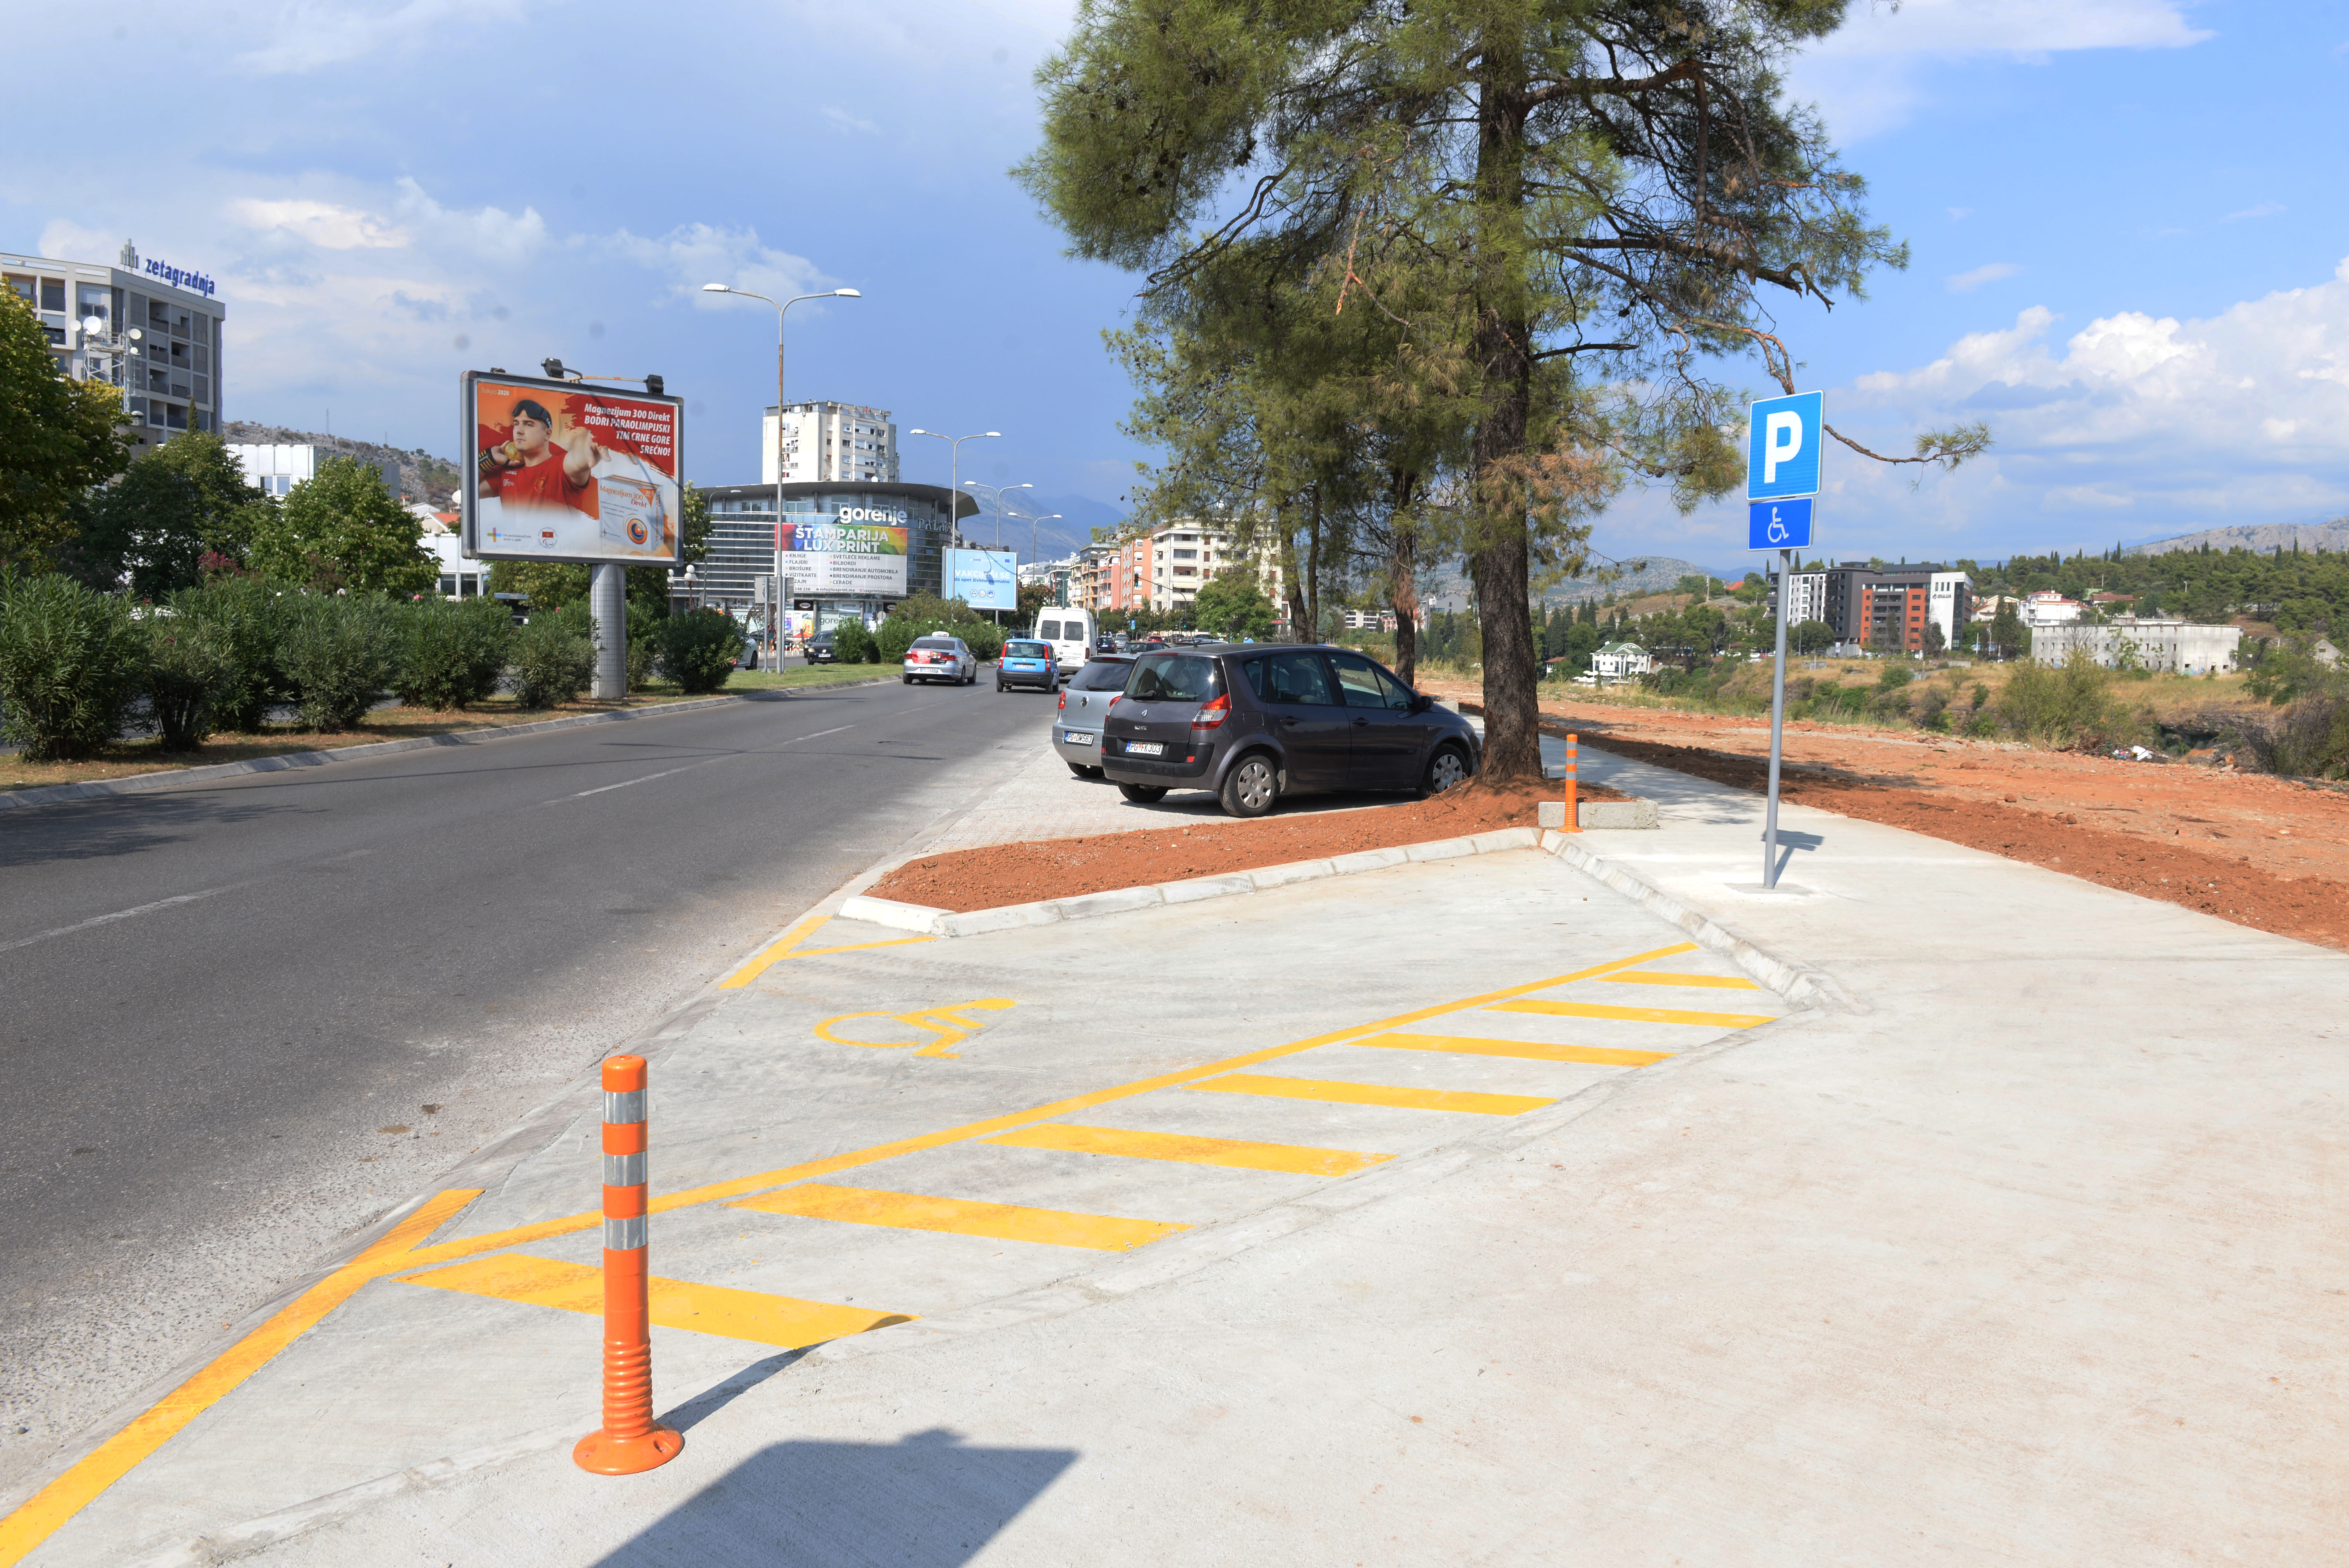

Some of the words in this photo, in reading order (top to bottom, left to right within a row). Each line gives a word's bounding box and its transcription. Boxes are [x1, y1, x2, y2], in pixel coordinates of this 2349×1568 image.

[145, 258, 215, 297] zetagradnja
[585, 403, 631, 418] Magnezijum
[633, 410, 647, 419] 300
[648, 411, 670, 422] Direkt
[585, 415, 609, 426] BODRI
[611, 419, 670, 433] PARAOLIMPIJSKI
[617, 431, 630, 440] TIM
[631, 433, 650, 442] CRNE
[651, 435, 670, 444] GORE
[640, 445, 670, 456] SREĆNO!
[1764, 410, 1802, 483] P
[600, 485, 632, 498] Magnezijum
[631, 499, 647, 508] Direkt
[840, 506, 907, 526] gorenje
[796, 525, 889, 542] ŠTAMPARIJA
[804, 540, 833, 551] LUX
[838, 541, 880, 553] PRINT
[1130, 742, 1138, 751] PG
[1141, 743, 1161, 753] FK303
